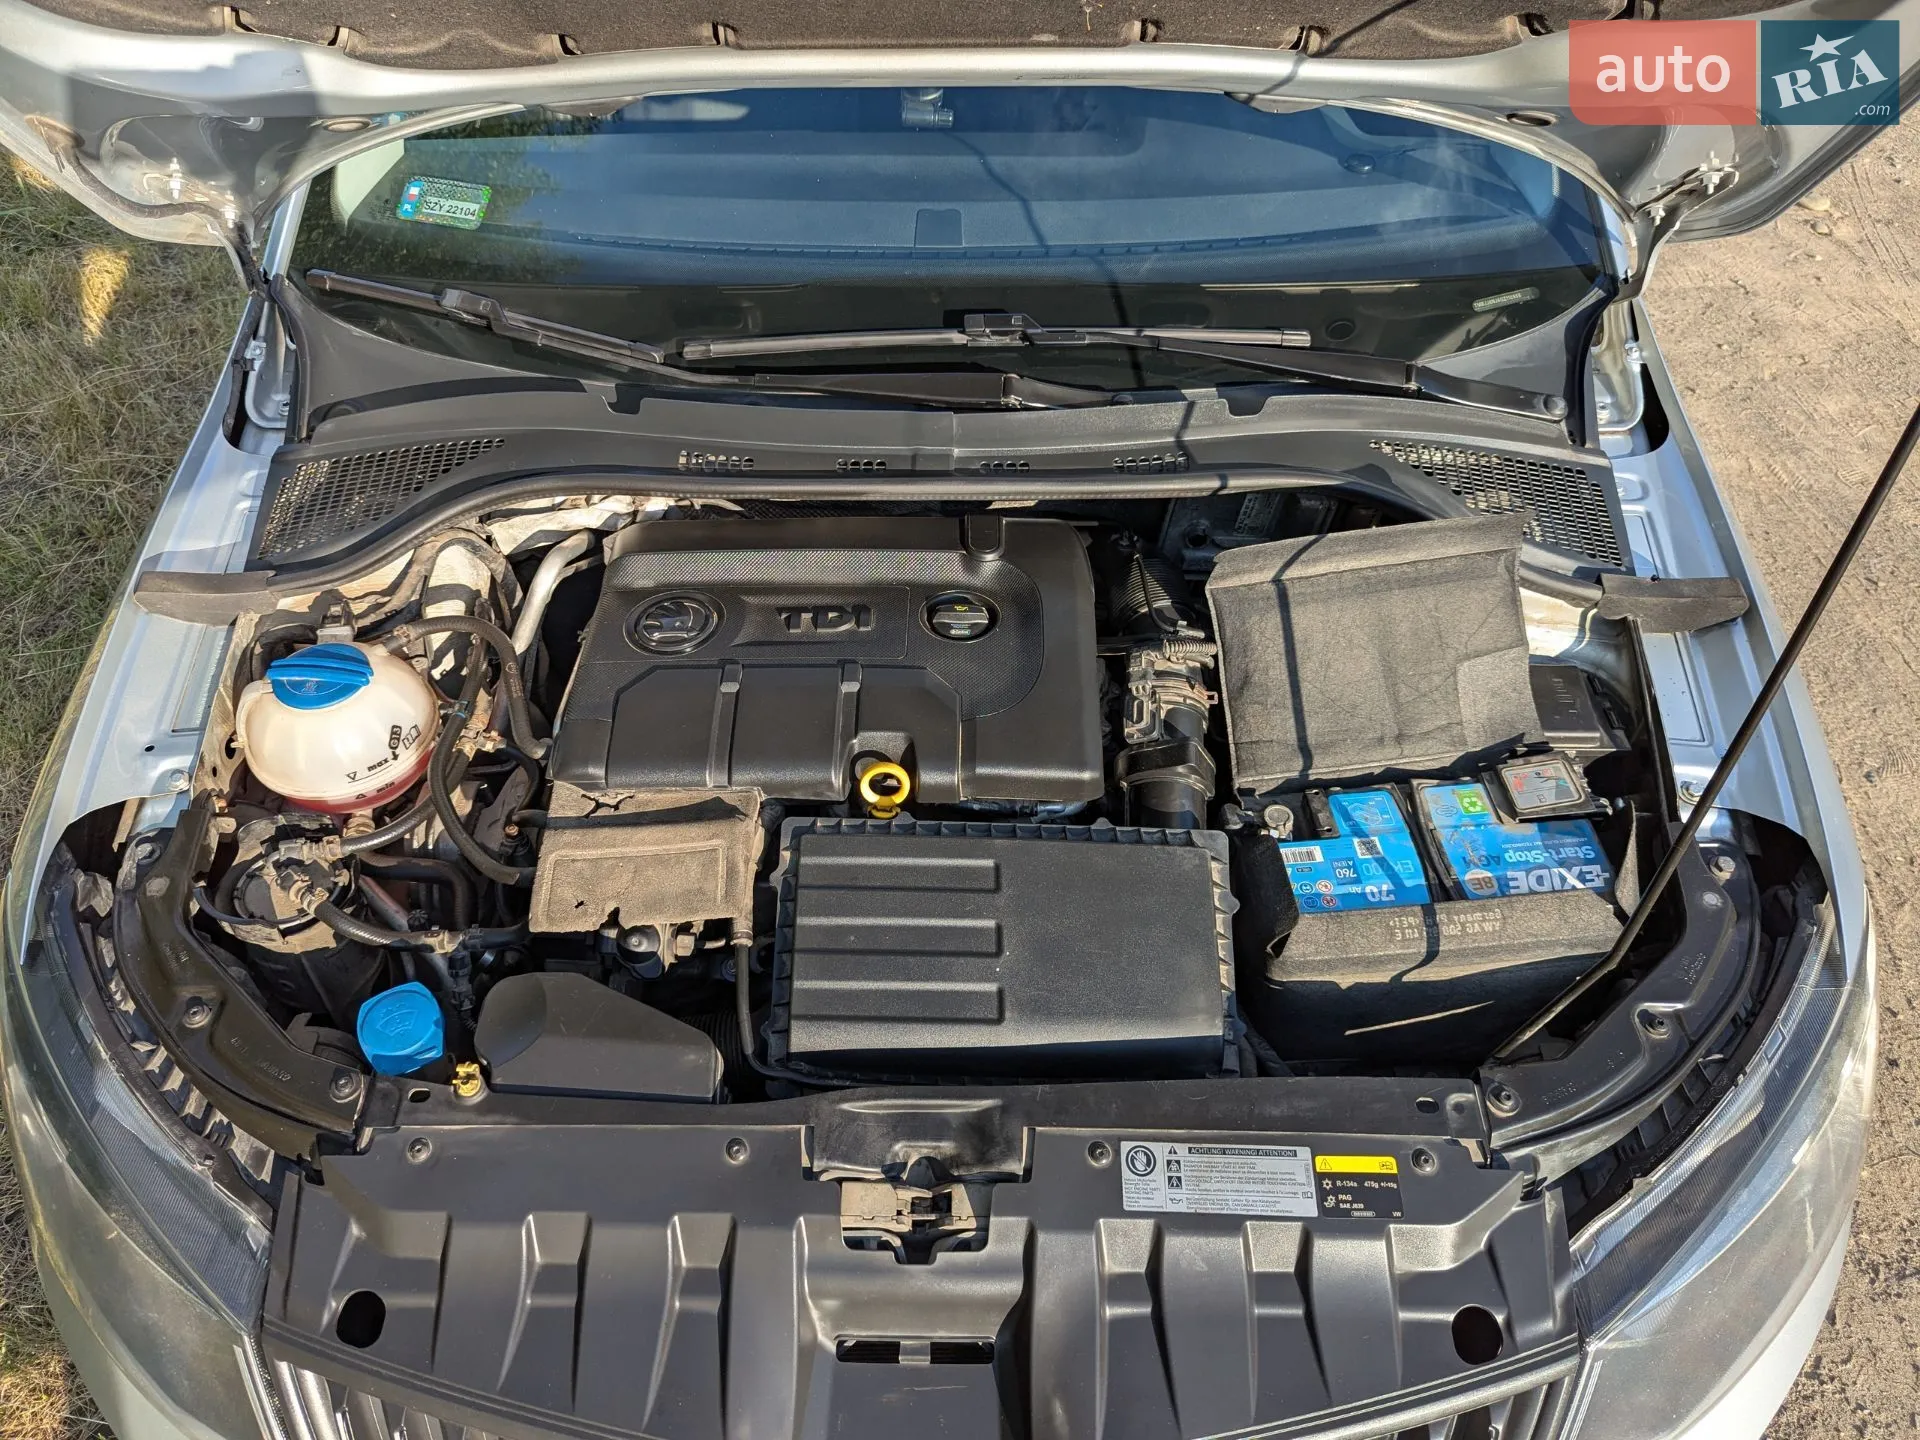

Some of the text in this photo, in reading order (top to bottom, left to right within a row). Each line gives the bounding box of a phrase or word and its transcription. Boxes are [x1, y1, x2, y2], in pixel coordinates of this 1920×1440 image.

[402, 203, 412, 212] PL
[423, 200, 477, 218] SZY 22104
[776, 606, 873, 632] TDI
[390, 727, 401, 749] G13
[367, 757, 390, 772] max
[376, 781, 396, 793] min
[1504, 845, 1596, 864] Start-Stop
[1335, 868, 1357, 879] 760
[1508, 865, 1609, 894] EXIDE
[1349, 884, 1396, 902] 70 Ah
